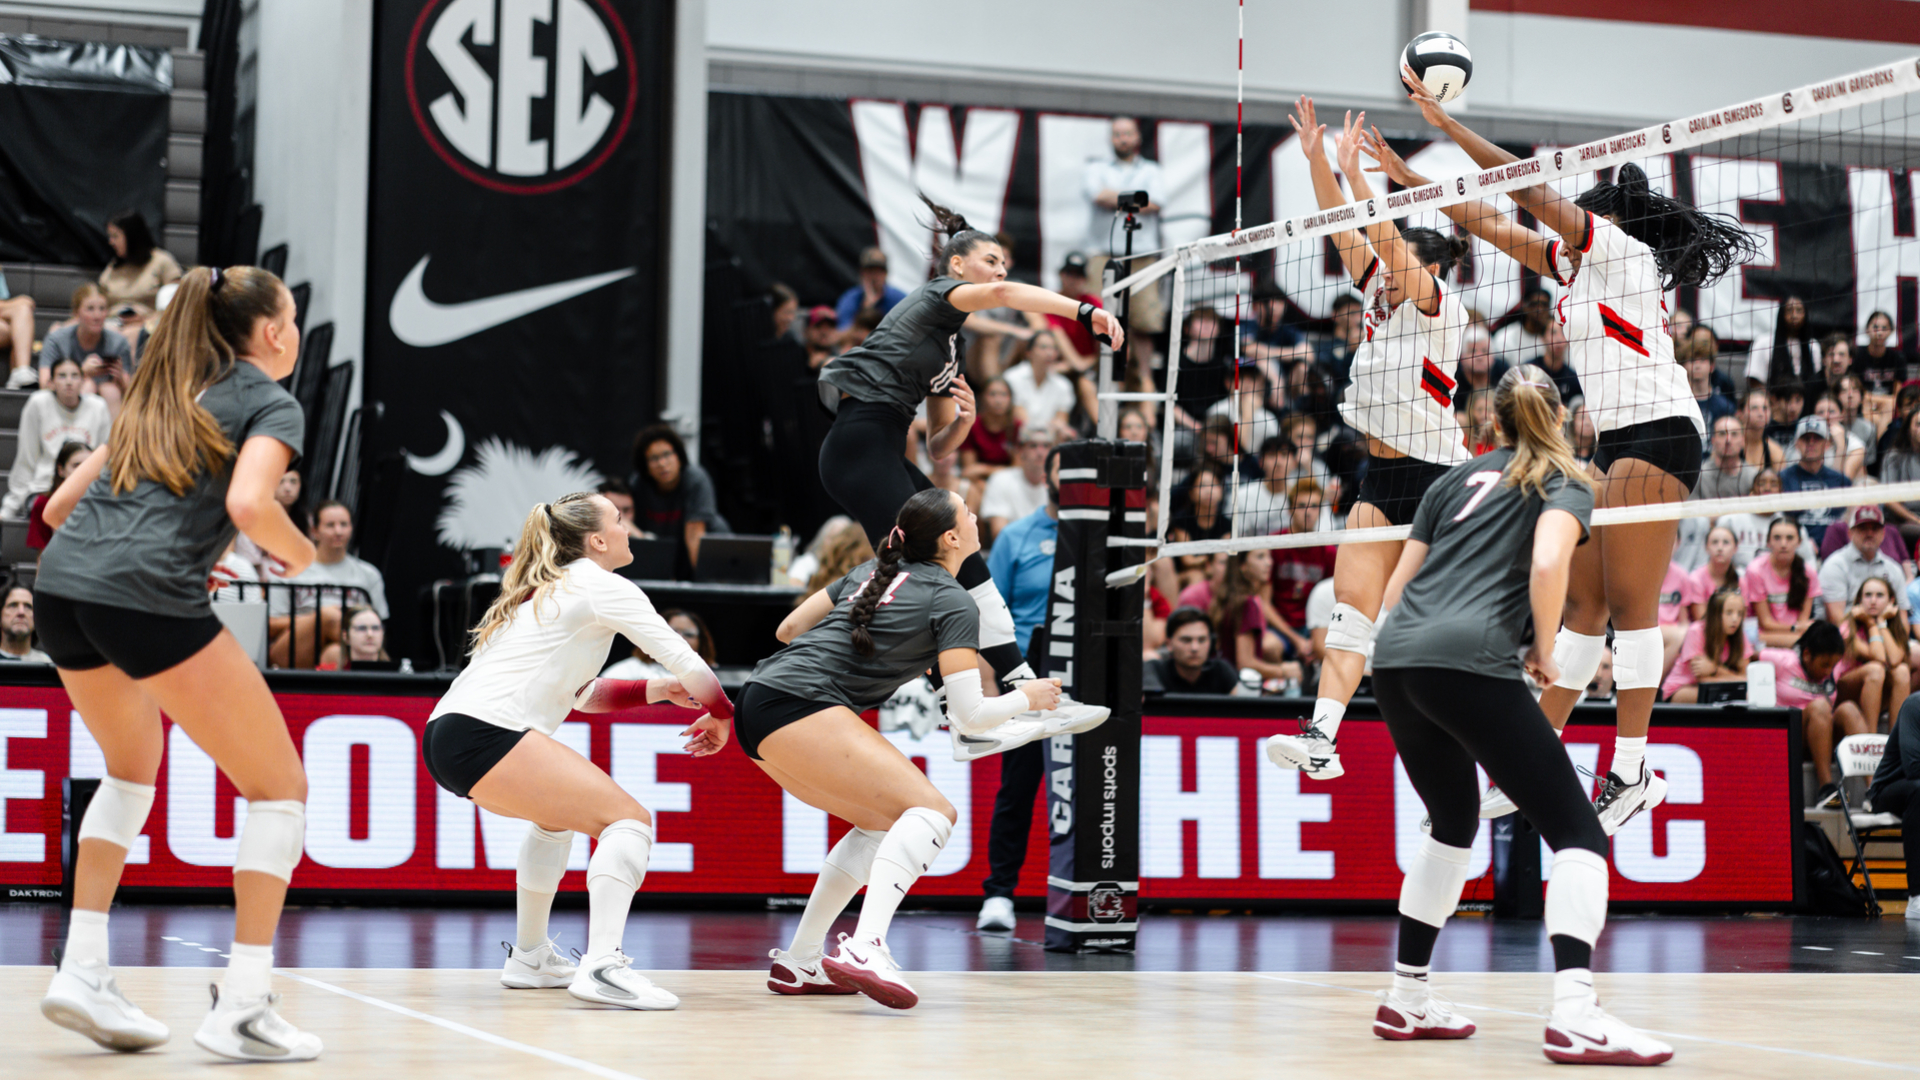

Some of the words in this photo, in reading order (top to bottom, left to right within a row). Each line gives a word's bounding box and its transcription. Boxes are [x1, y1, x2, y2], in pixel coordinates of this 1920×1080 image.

[426, 0, 618, 176] SEC
[1812, 81, 1847, 102] CAROLINA
[1850, 69, 1894, 93] GAMECOCKS
[1689, 113, 1722, 133] CAROLINA
[1723, 103, 1764, 124] GAMECOCKS
[1610, 133, 1647, 155] GAMECOCKS
[1478, 169, 1506, 187] CAROLINA
[1506, 160, 1540, 181] GAMECOCKS
[1387, 192, 1412, 209] CAROLINA
[1413, 185, 1443, 203] GAMECOCKS
[1303, 212, 1327, 229] CAROLINA
[1327, 207, 1355, 224] GAMECOCKS
[1453, 470, 1502, 521] 7
[1049, 566, 1076, 834] CARLINA
[1103, 745, 1118, 799] sports
[1101, 802, 1116, 868] imports
